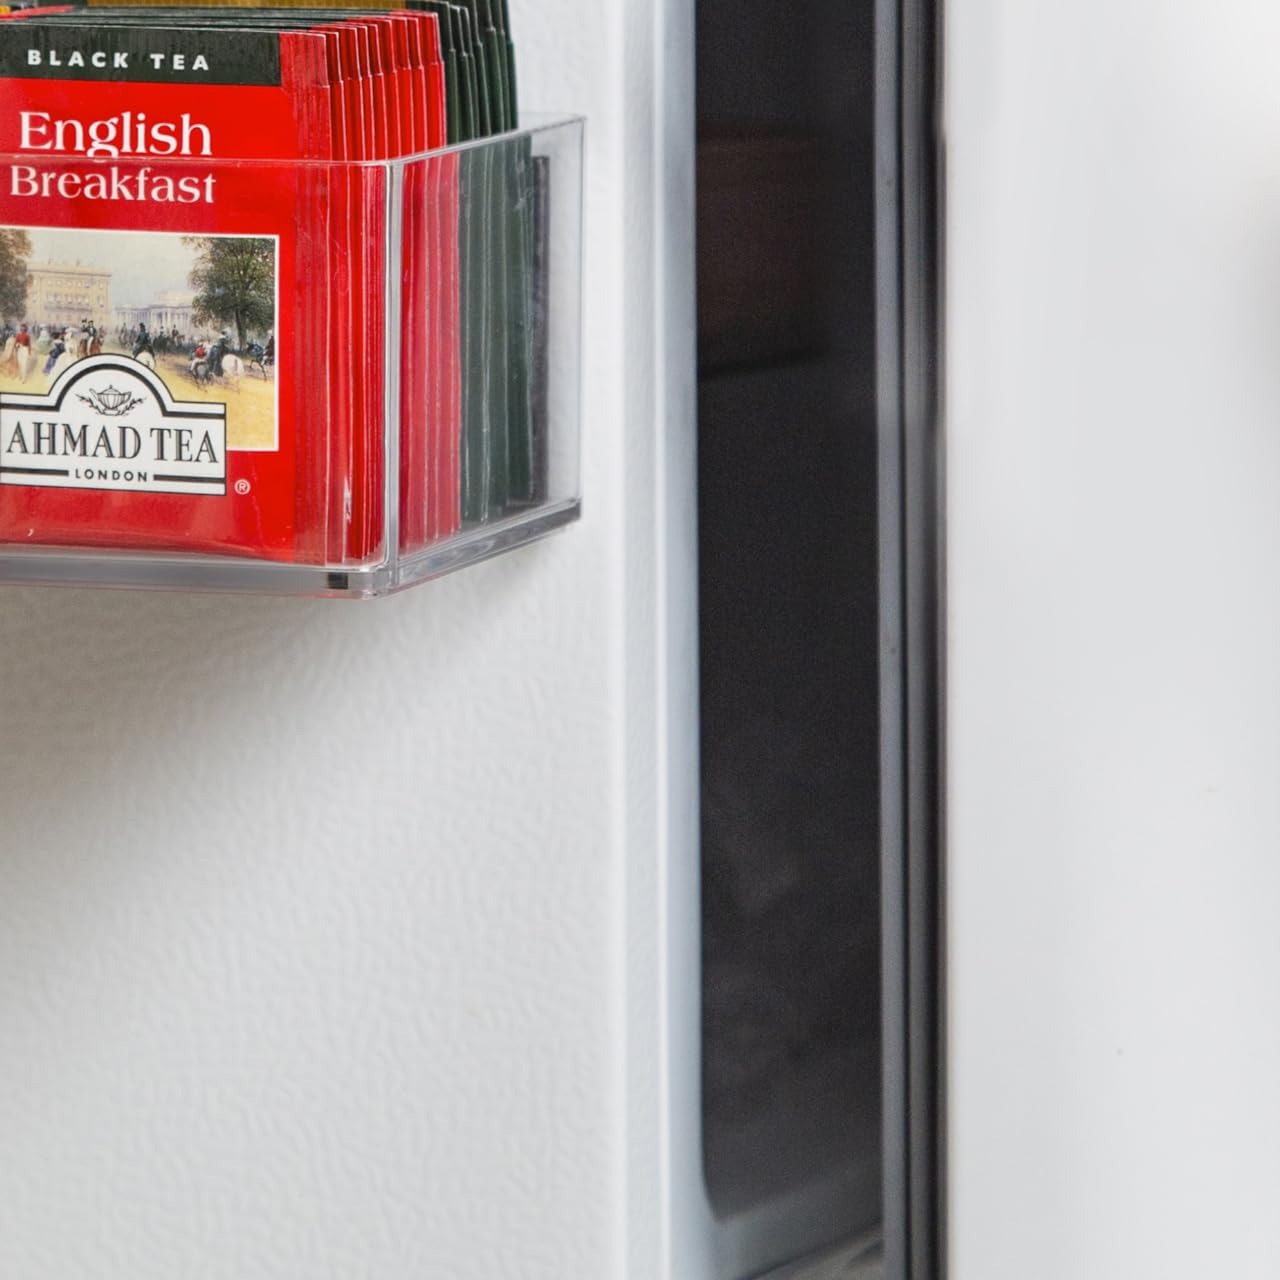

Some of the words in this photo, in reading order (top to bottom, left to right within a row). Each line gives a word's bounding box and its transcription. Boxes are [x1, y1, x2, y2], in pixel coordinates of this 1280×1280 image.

[27, 50, 129, 69] BLACK
[150, 53, 210, 71] TEA
[19, 110, 213, 161] English
[10, 165, 216, 204] Breakfast
[6, 421, 142, 460] AHMAD
[150, 428, 219, 464] TEA
[75, 469, 149, 483] LONDON
